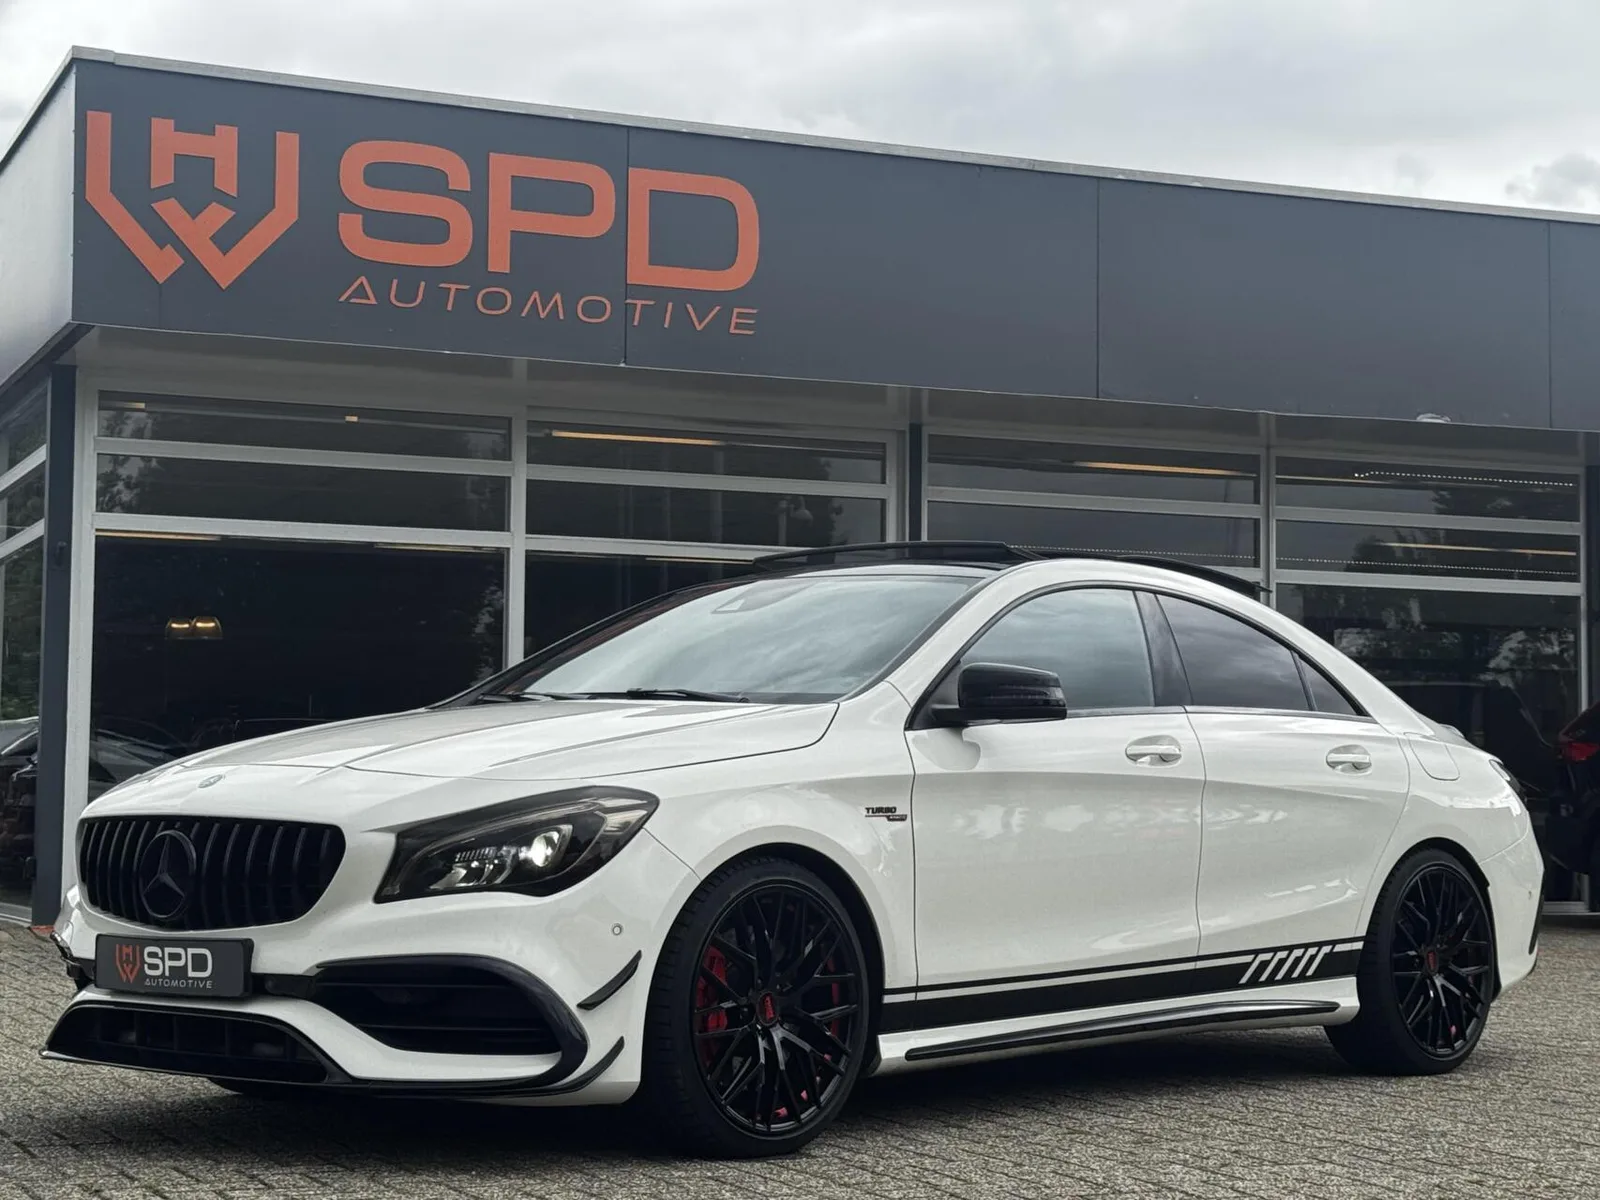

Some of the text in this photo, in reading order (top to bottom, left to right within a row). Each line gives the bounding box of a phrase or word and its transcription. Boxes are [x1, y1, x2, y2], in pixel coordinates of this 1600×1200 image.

[338, 140, 760, 291] SPD
[338, 275, 759, 335] AUTOMOTIVE
[865, 806, 897, 814] TURBO
[144, 946, 213, 978] SPD
[144, 978, 213, 989] AUTOMOTIVE
